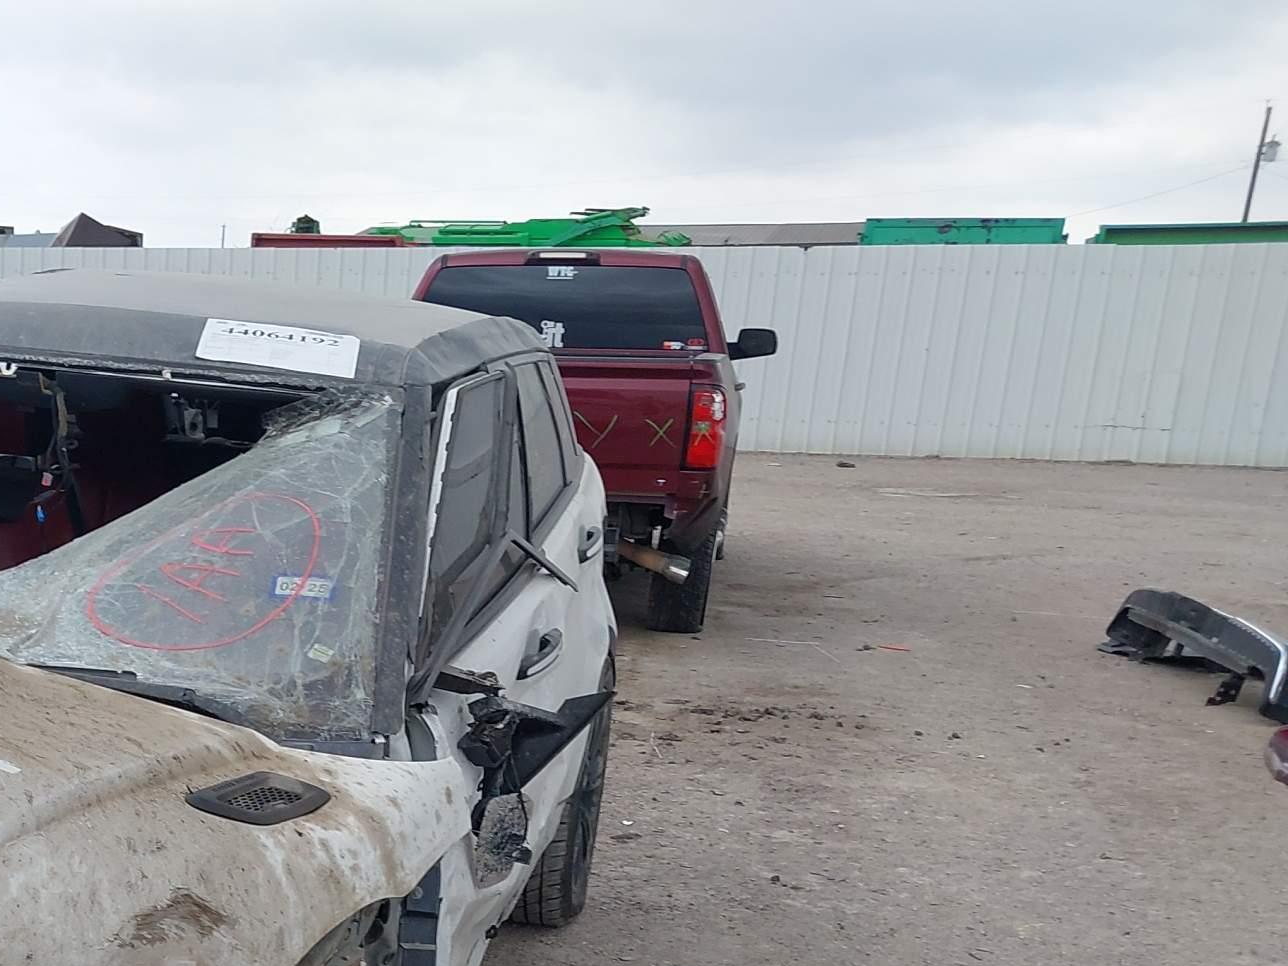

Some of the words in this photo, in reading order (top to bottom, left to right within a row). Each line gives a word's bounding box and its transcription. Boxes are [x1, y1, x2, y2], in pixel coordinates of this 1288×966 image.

[221, 327, 341, 347] 44064192
[135, 526, 259, 626] IAA
[308, 583, 329, 593] 25
